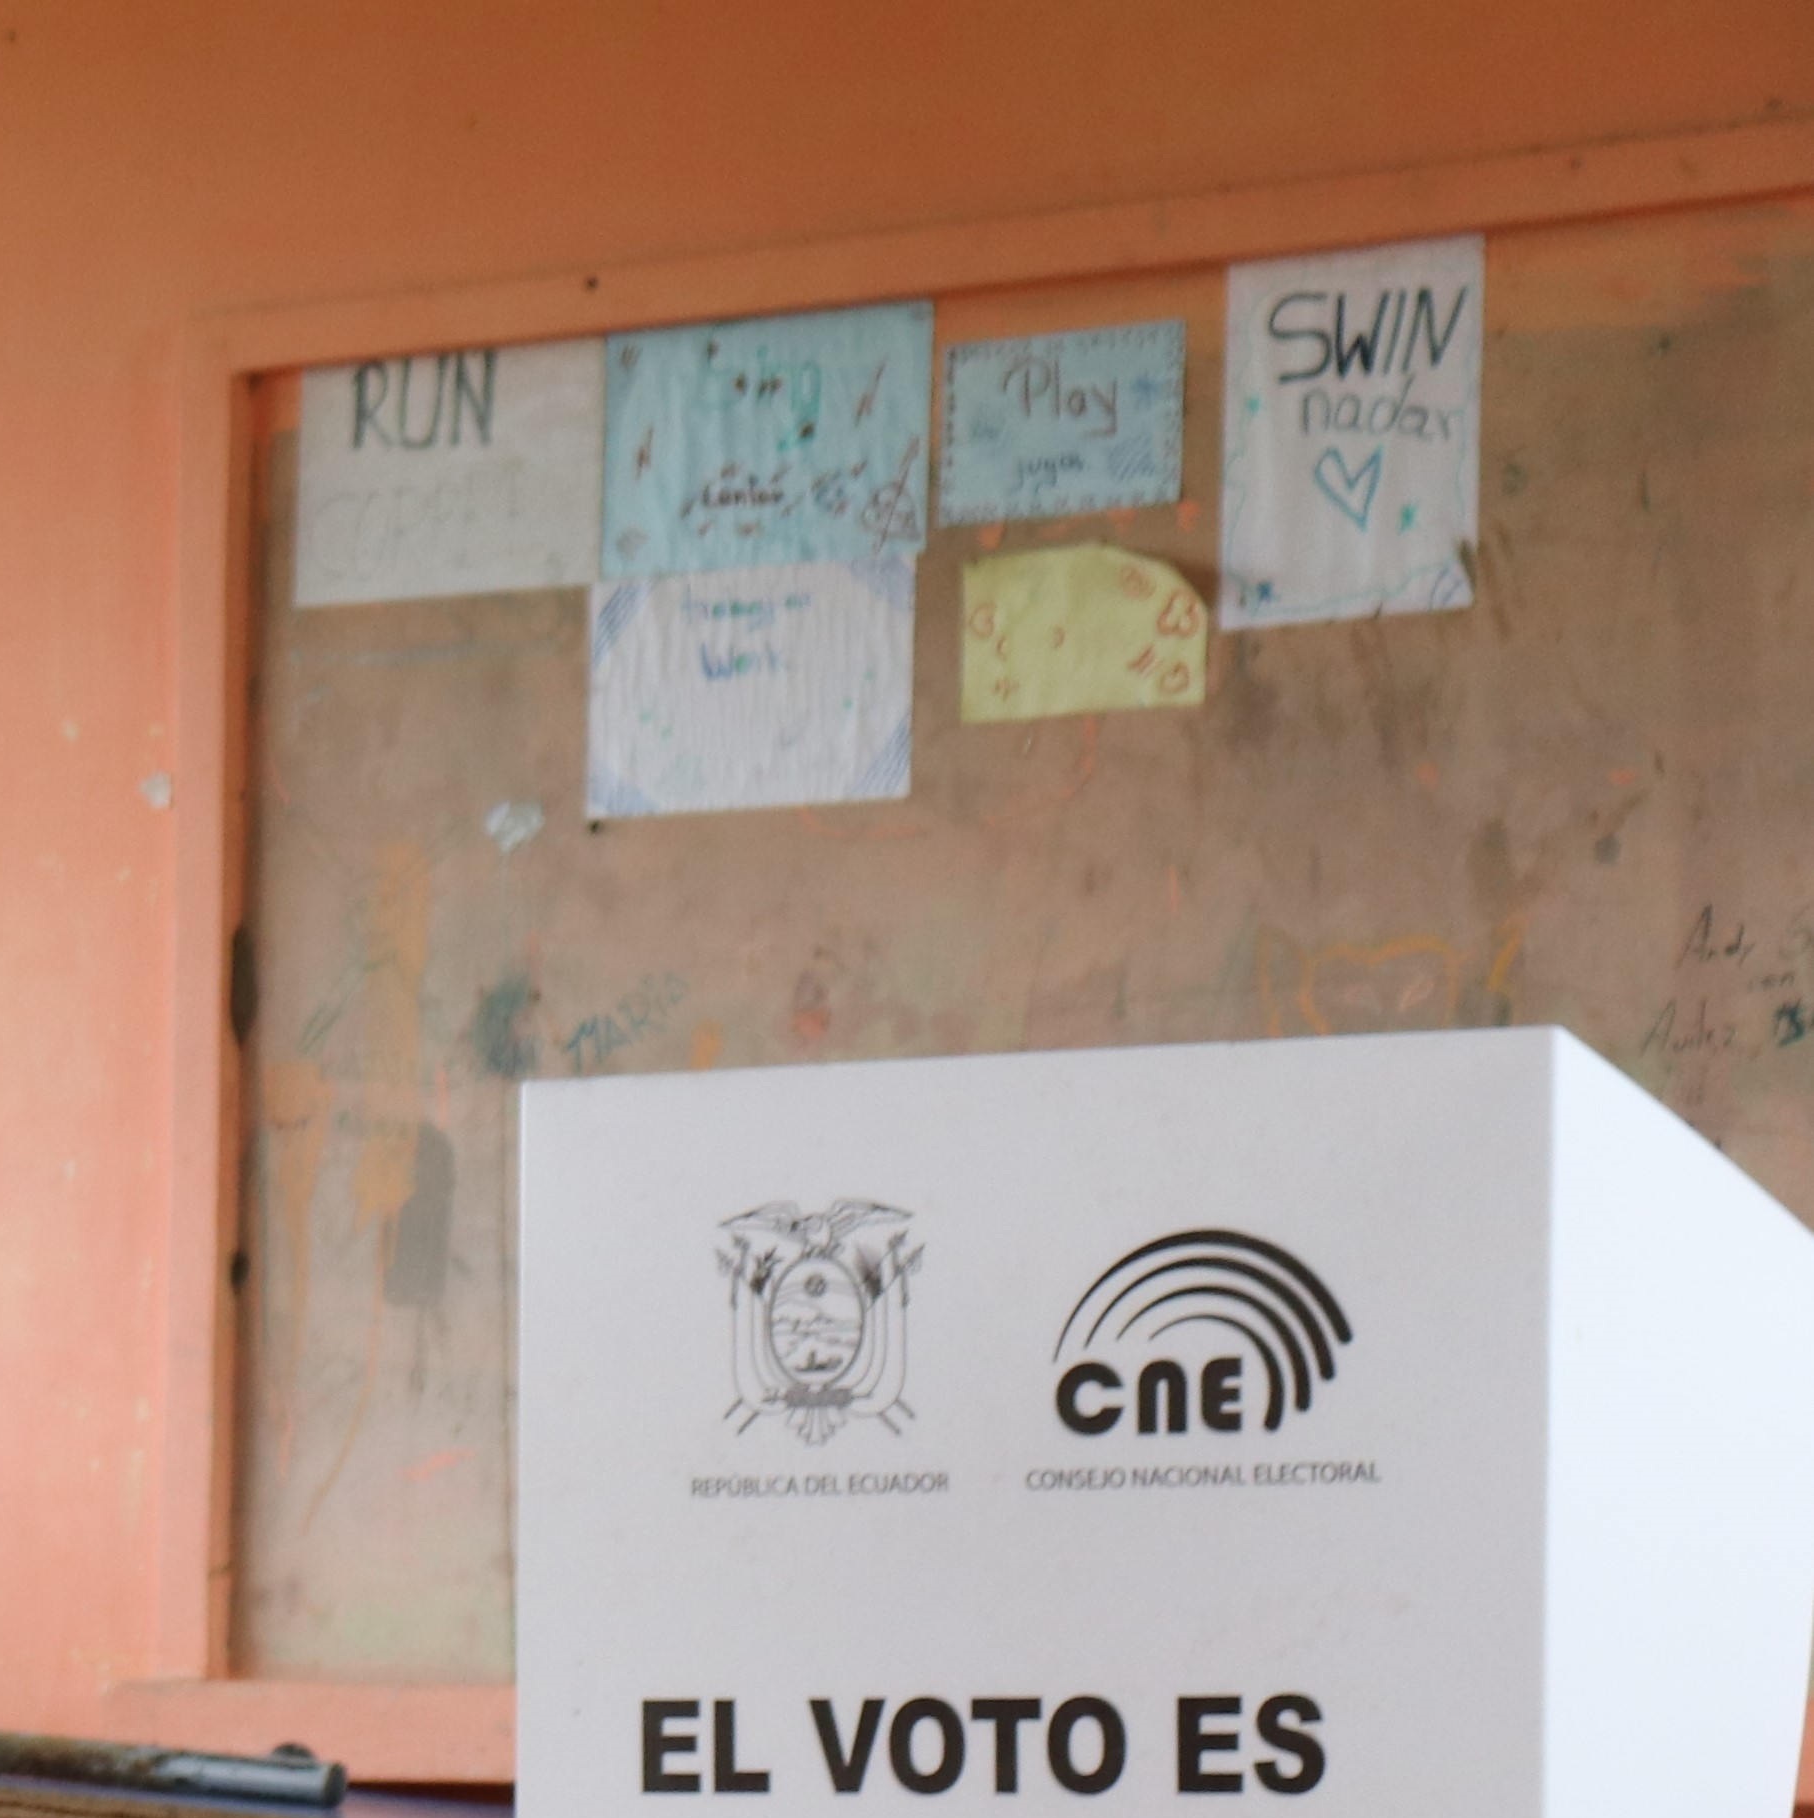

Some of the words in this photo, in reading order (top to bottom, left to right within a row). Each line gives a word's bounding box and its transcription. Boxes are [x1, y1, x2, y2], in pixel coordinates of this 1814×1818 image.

[1268, 285, 1468, 384] SWIN
[350, 350, 498, 450] RUN
[1002, 355, 1119, 440] Play
[1299, 377, 1456, 441] nadar
[691, 1474, 799, 1498] REPÚBLICA
[804, 1475, 844, 1497] DEL
[848, 1472, 949, 1496] ECUADOR
[1026, 1467, 1126, 1491] CONSEJO
[1131, 1464, 1247, 1488] NACIONAL
[1253, 1460, 1382, 1486] ELECTORAL
[642, 1699, 771, 1794] EL
[808, 1695, 1127, 1796] VOTO
[1176, 1693, 1326, 1797] ES
